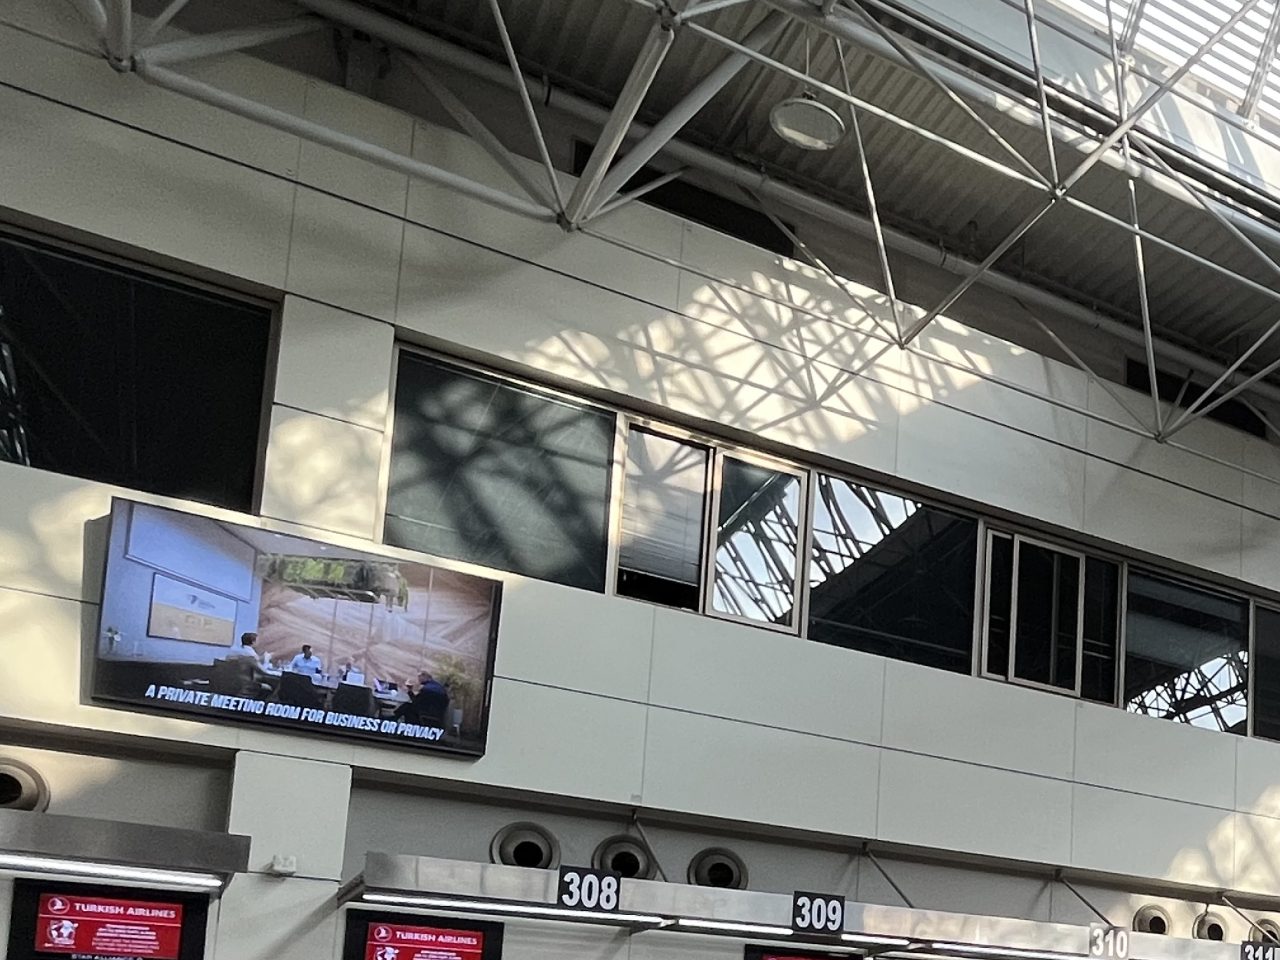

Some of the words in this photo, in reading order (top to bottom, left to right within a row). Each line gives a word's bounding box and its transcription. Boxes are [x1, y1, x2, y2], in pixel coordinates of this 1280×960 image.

[145, 684, 155, 698] A
[157, 686, 209, 706] PRIVATE
[211, 692, 263, 714] MEETING
[265, 700, 301, 721] ROOM
[301, 706, 324, 724] FOR
[326, 710, 381, 733] BUSINESS
[380, 719, 397, 735] OR
[397, 721, 444, 742] PRIVACY
[561, 872, 619, 911] 308
[73, 902, 124, 915] TURKISH
[127, 907, 176, 919] AIRLINES
[795, 896, 843, 931] 309
[395, 930, 436, 942] TURKISH
[437, 935, 478, 945] AIRLINES
[1091, 927, 1128, 959] 310
